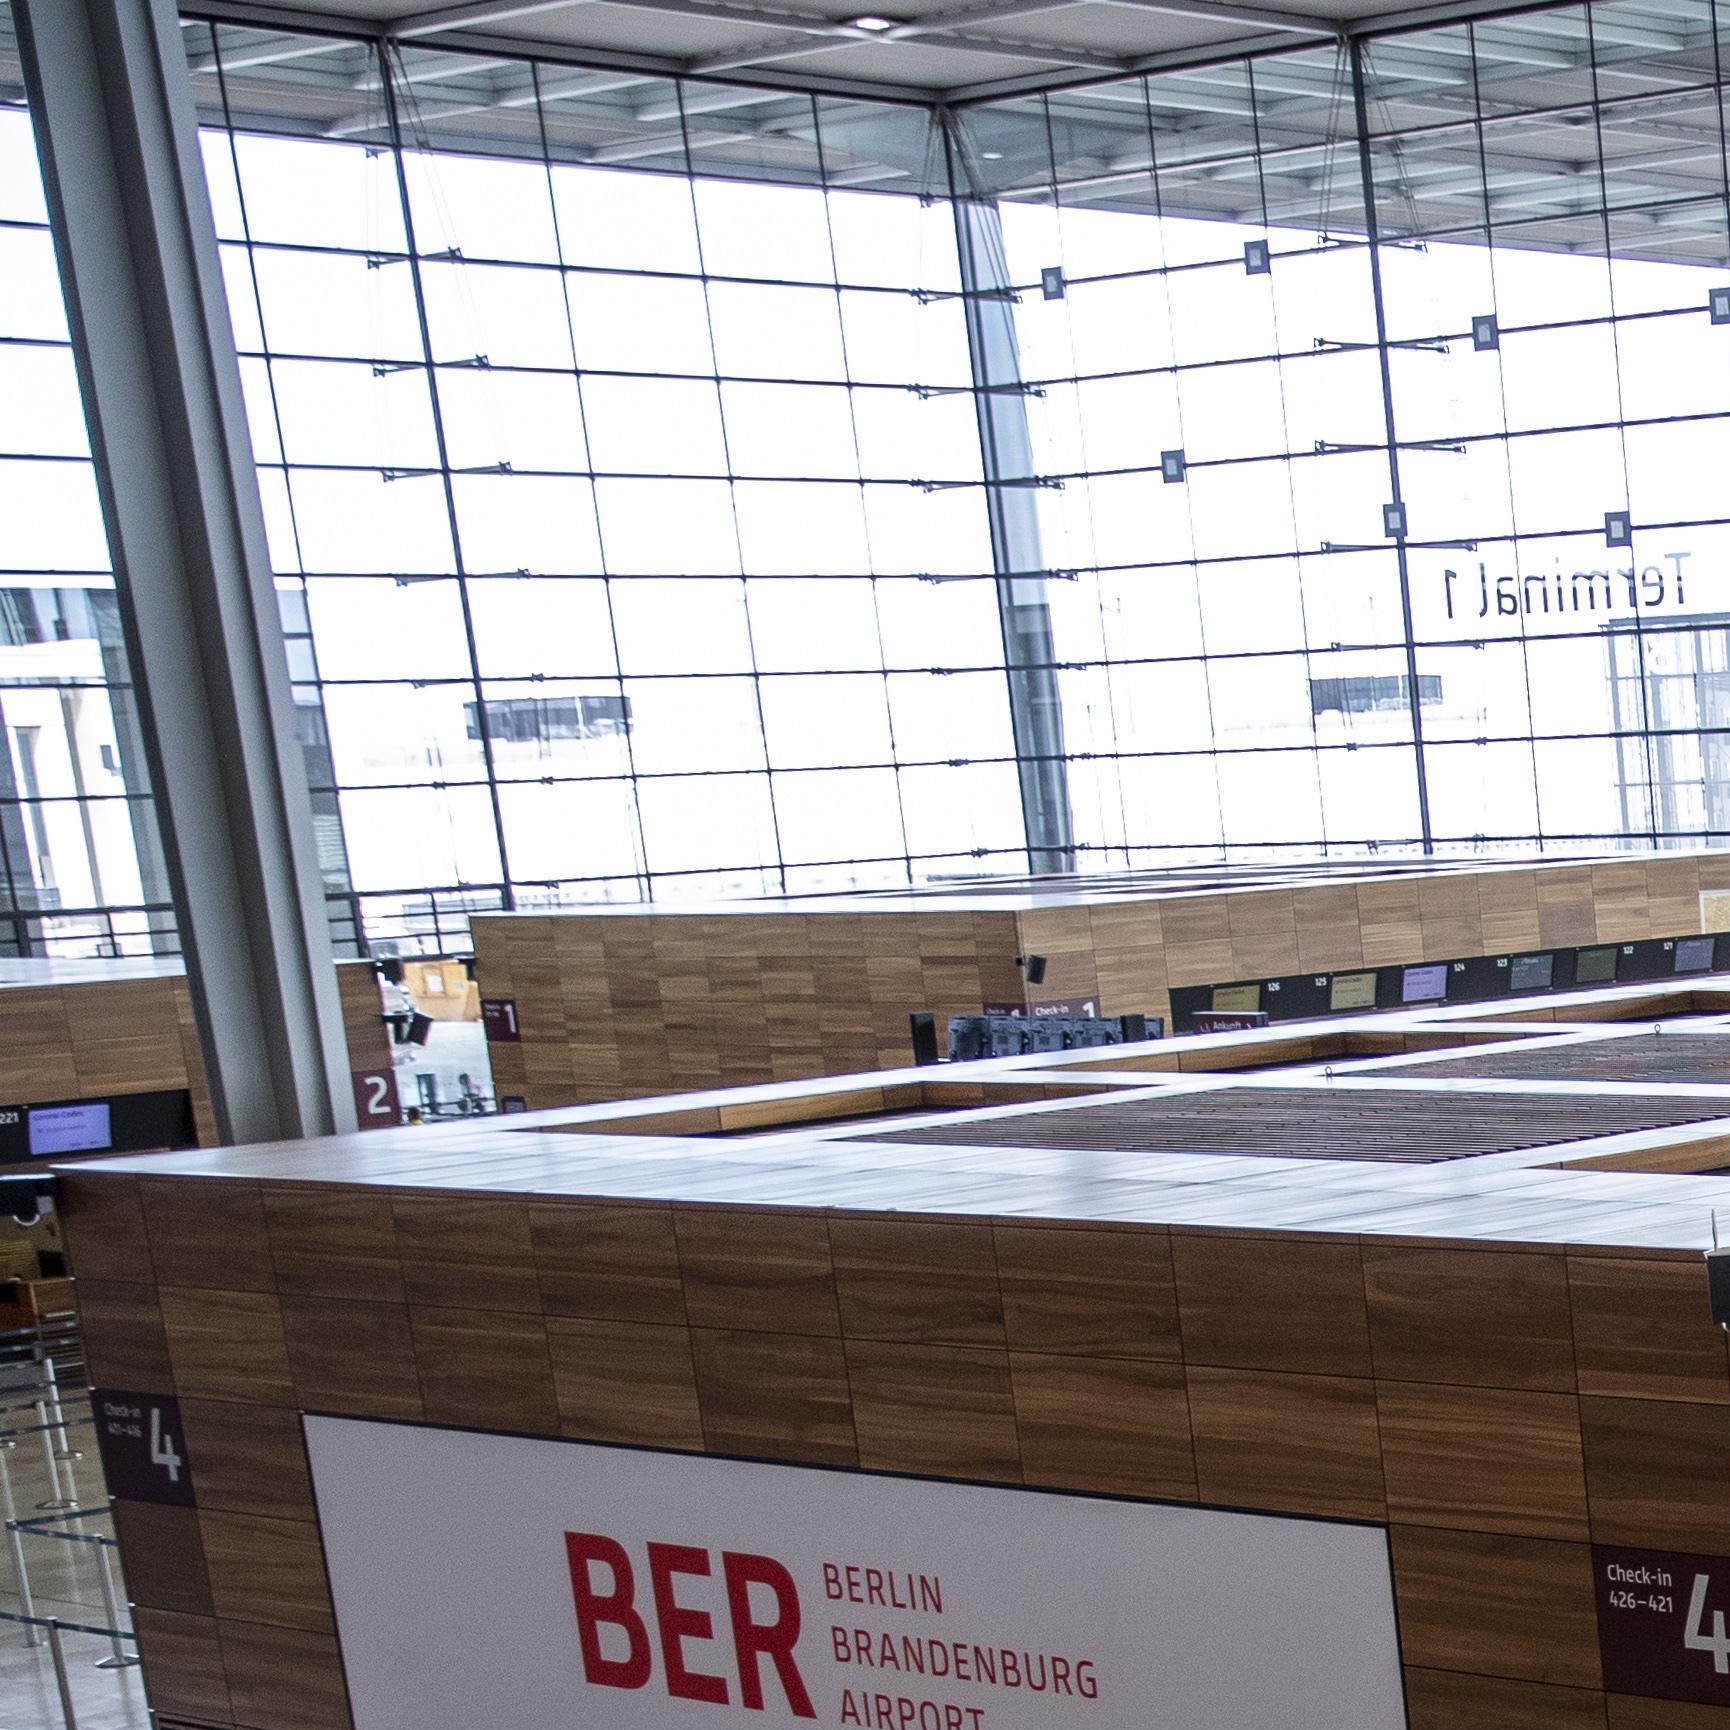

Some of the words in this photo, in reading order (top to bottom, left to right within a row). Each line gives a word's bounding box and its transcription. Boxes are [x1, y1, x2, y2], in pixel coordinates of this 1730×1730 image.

[1267, 982, 1281, 992] 126
[504, 1003, 517, 1035] 1
[1034, 1003, 1070, 1017] Check-in
[363, 1076, 392, 1115] 2
[150, 1407, 182, 1482] 4
[822, 1562, 944, 1615] BERLIN
[1607, 1563, 1673, 1588] Check-in
[563, 1530, 818, 1720] BER
[832, 1625, 1100, 1700] BRANDENBURG
